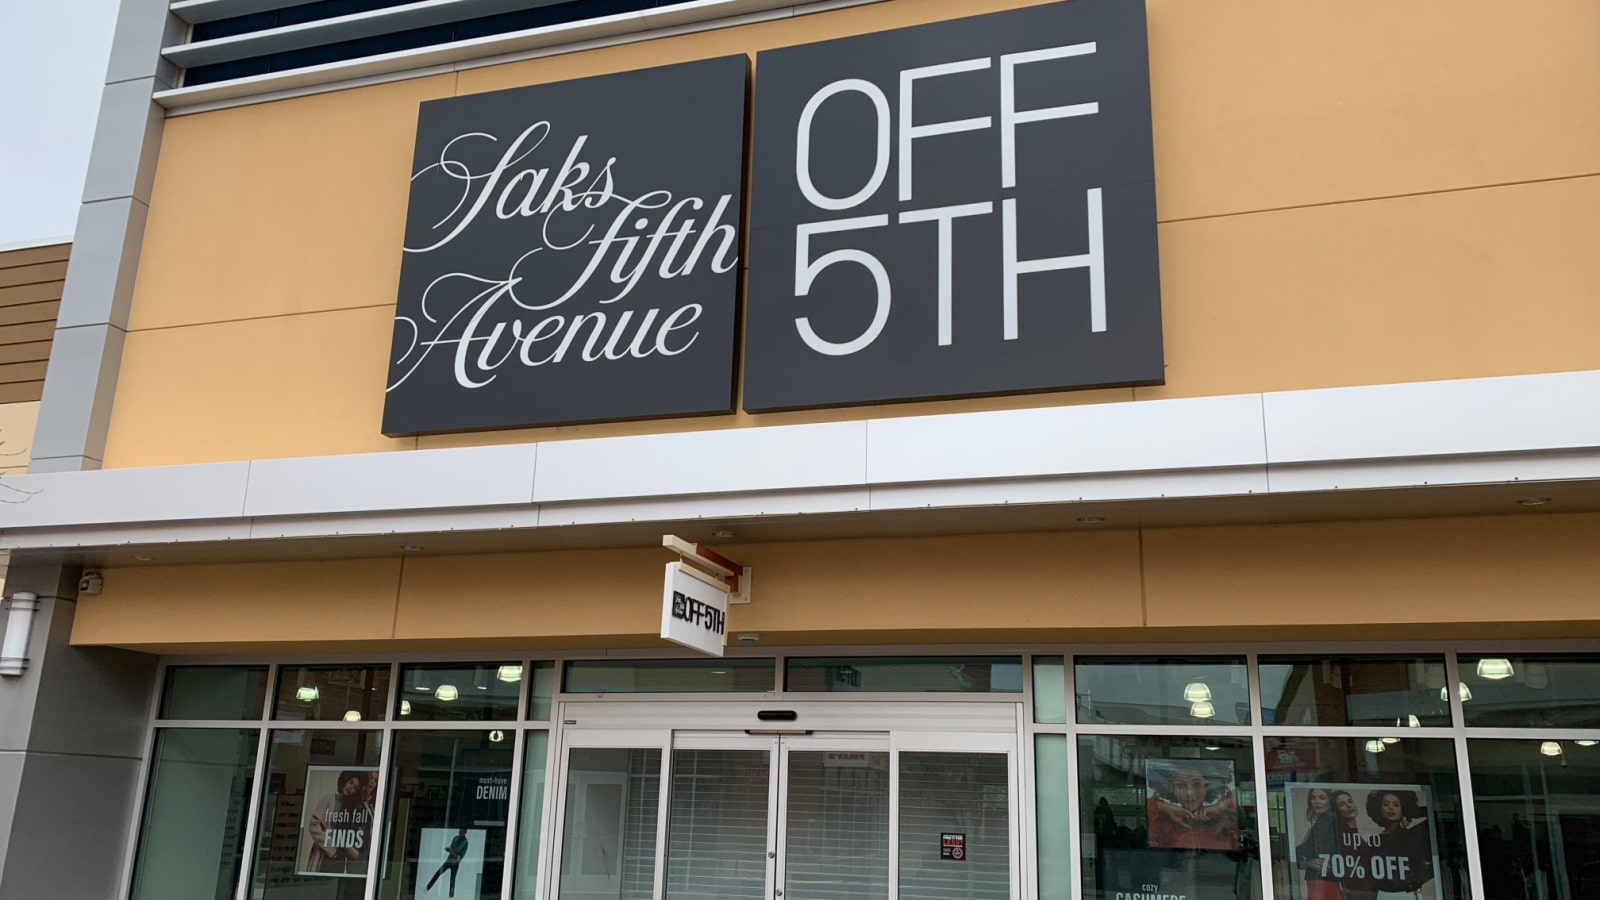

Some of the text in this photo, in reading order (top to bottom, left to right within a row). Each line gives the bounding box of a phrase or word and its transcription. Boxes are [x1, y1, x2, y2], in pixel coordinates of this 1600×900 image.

[795, 41, 1099, 210] OFF
[404, 121, 616, 252] Saks
[795, 187, 1107, 356] 5TH
[386, 273, 703, 389] Avenue
[684, 596, 705, 626] OFF
[705, 604, 726, 635] 5TH
[476, 785, 508, 800] DENIM
[325, 808, 368, 823] fresh fall
[324, 829, 364, 849] FINDS
[1343, 829, 1381, 850] up to
[1318, 854, 1410, 881] 70% OFF
[1141, 883, 1159, 894] cozy
